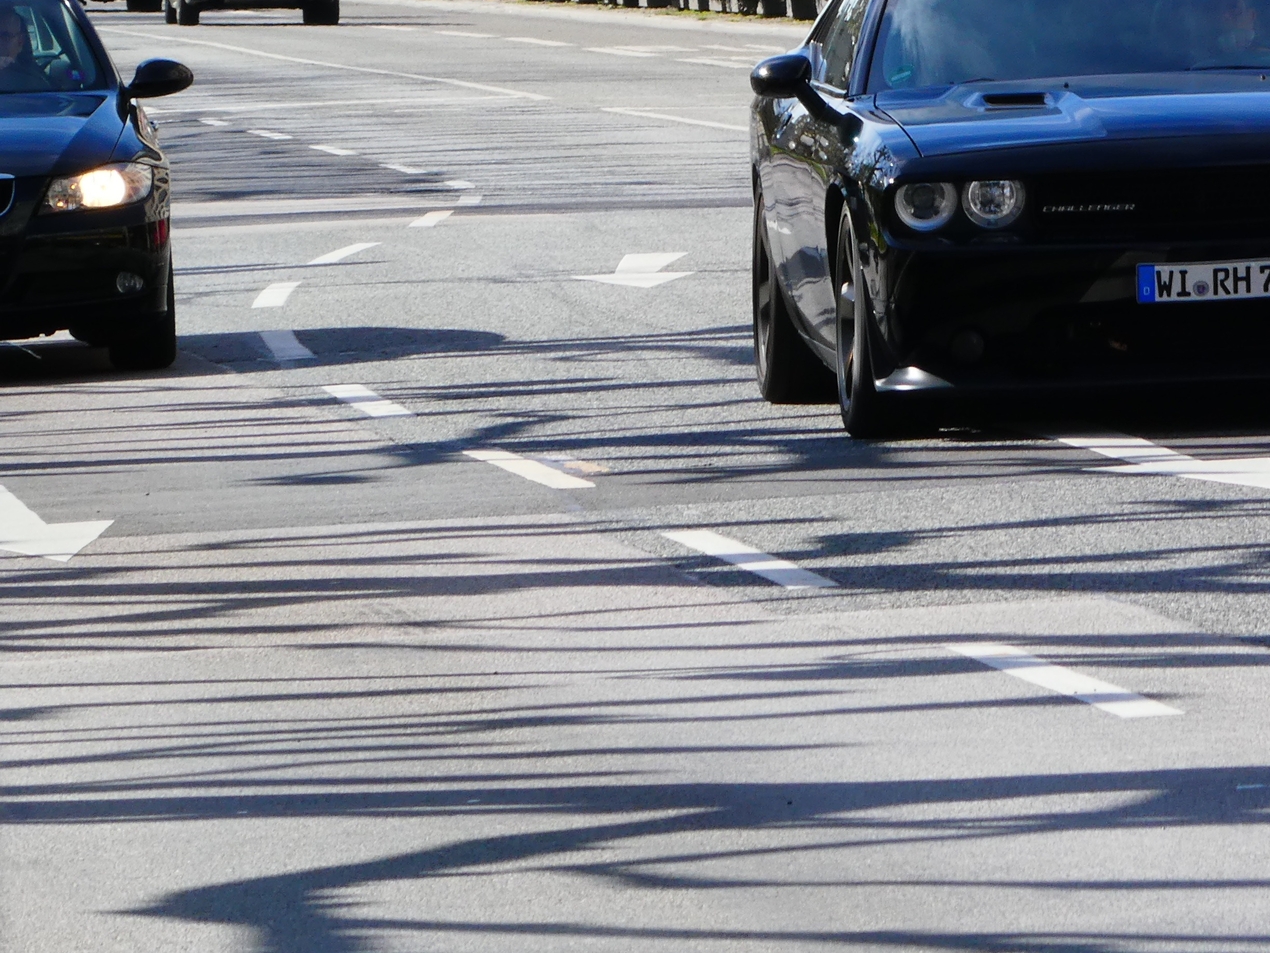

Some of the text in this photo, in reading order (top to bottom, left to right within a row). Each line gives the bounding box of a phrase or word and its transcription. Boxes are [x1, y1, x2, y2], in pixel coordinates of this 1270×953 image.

[1043, 203, 1136, 213] CHALLENGER
[1155, 269, 1192, 298] WI
[1212, 266, 1251, 296] RH
